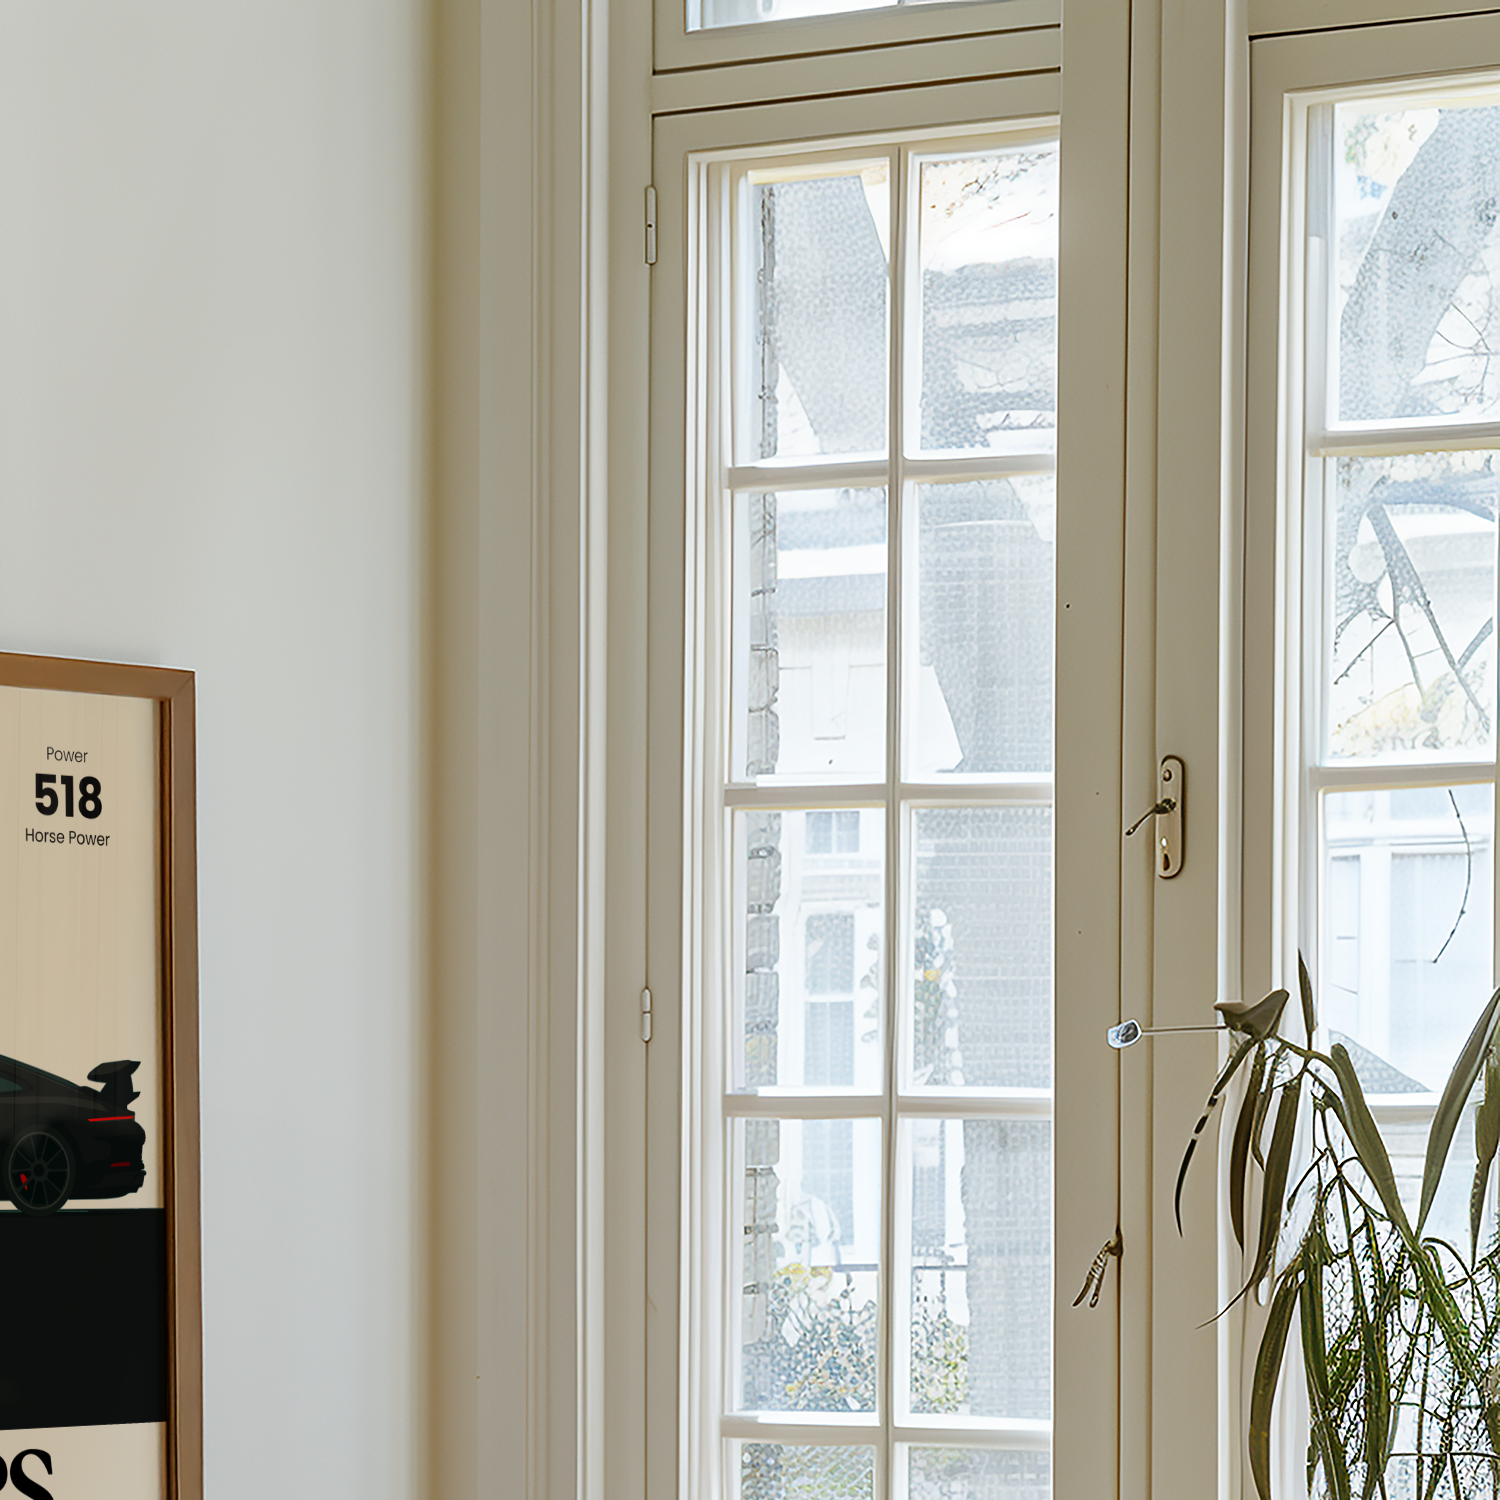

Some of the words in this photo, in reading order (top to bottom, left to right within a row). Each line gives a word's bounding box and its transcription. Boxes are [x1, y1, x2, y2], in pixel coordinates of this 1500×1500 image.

[46, 746, 89, 763] Power
[35, 773, 102, 819] 518
[25, 828, 65, 844] Horse
[68, 830, 110, 847] Power
